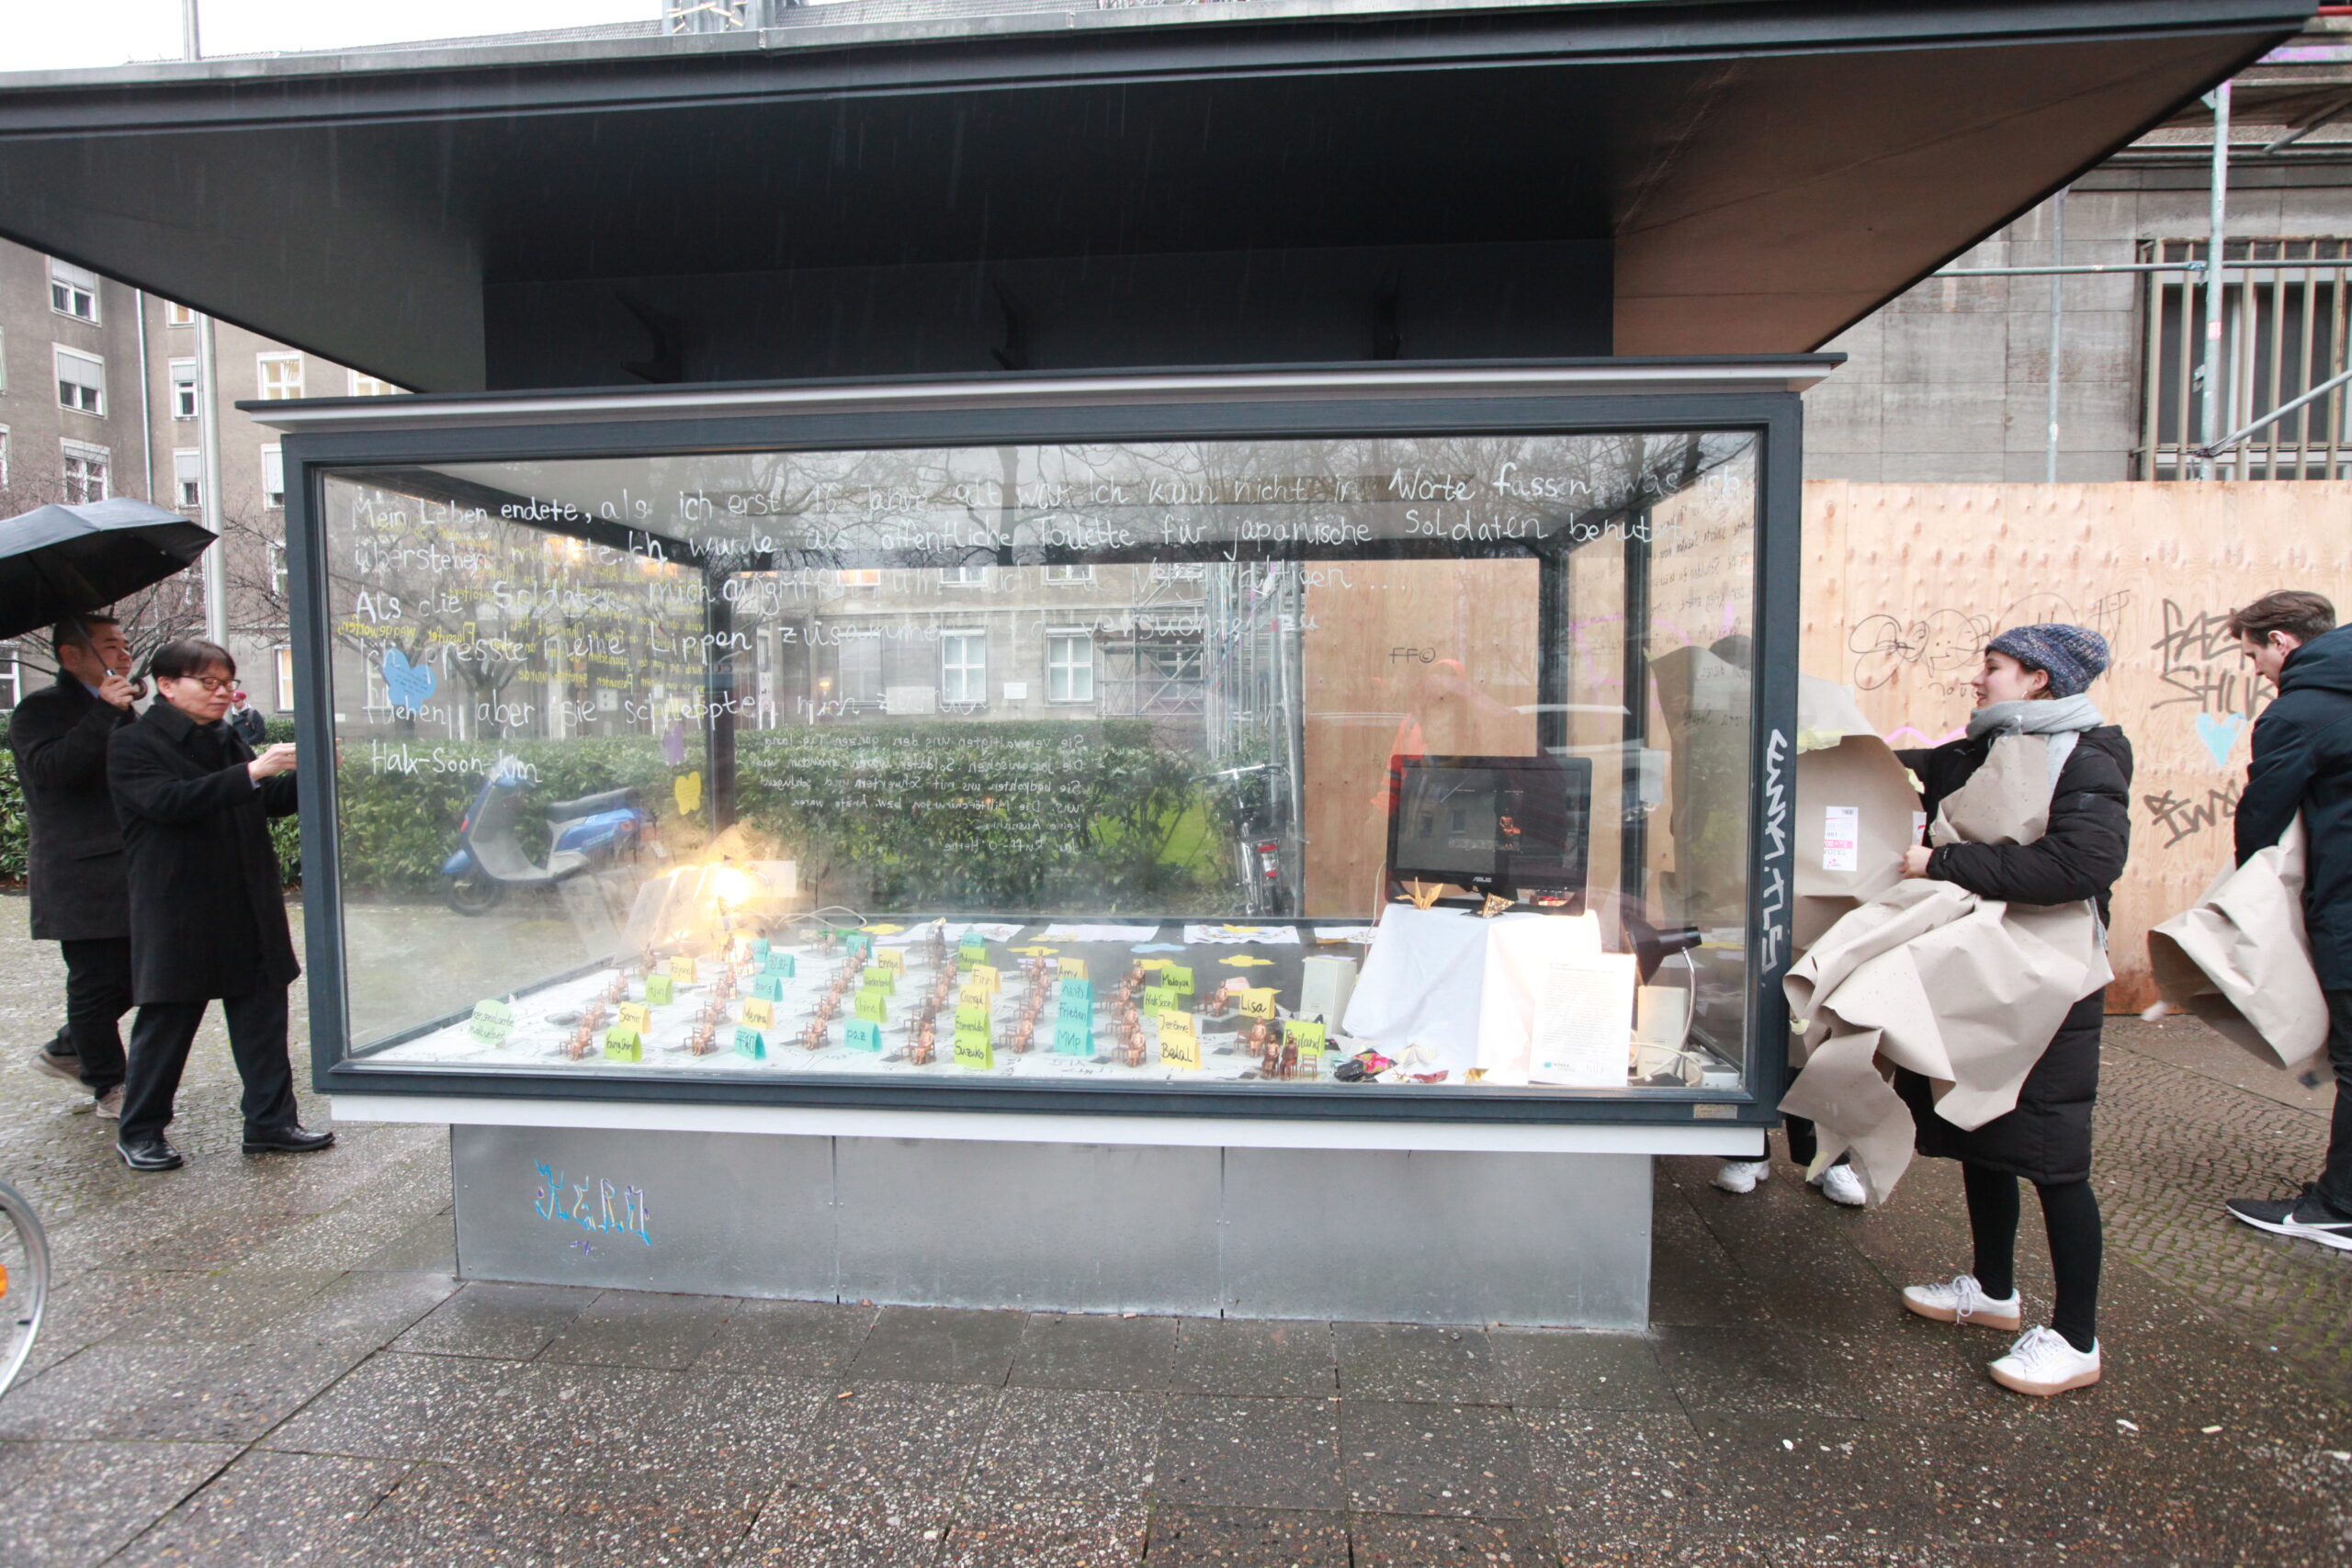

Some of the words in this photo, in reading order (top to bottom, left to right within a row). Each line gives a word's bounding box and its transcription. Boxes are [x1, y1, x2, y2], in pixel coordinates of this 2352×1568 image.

[352, 498, 407, 530] Mein
[420, 497, 488, 524] Leben
[501, 496, 591, 523] endete,
[602, 489, 649, 522] als
[679, 489, 713, 521] ich
[728, 491, 783, 516] erst
[955, 479, 1001, 506] alt
[1148, 477, 1218, 504] kann
[1234, 474, 1308, 502] nicht
[1335, 473, 1363, 502] in
[1388, 468, 1476, 502] Worte
[689, 524, 778, 557] wurde
[1032, 515, 1135, 550] Toilette
[1161, 514, 1206, 545] für
[1224, 516, 1373, 561] japanische
[649, 580, 716, 609] mich
[650, 621, 752, 666] Lippen
[477, 688, 536, 728] aber
[1241, 993, 1267, 1013] Lisa
